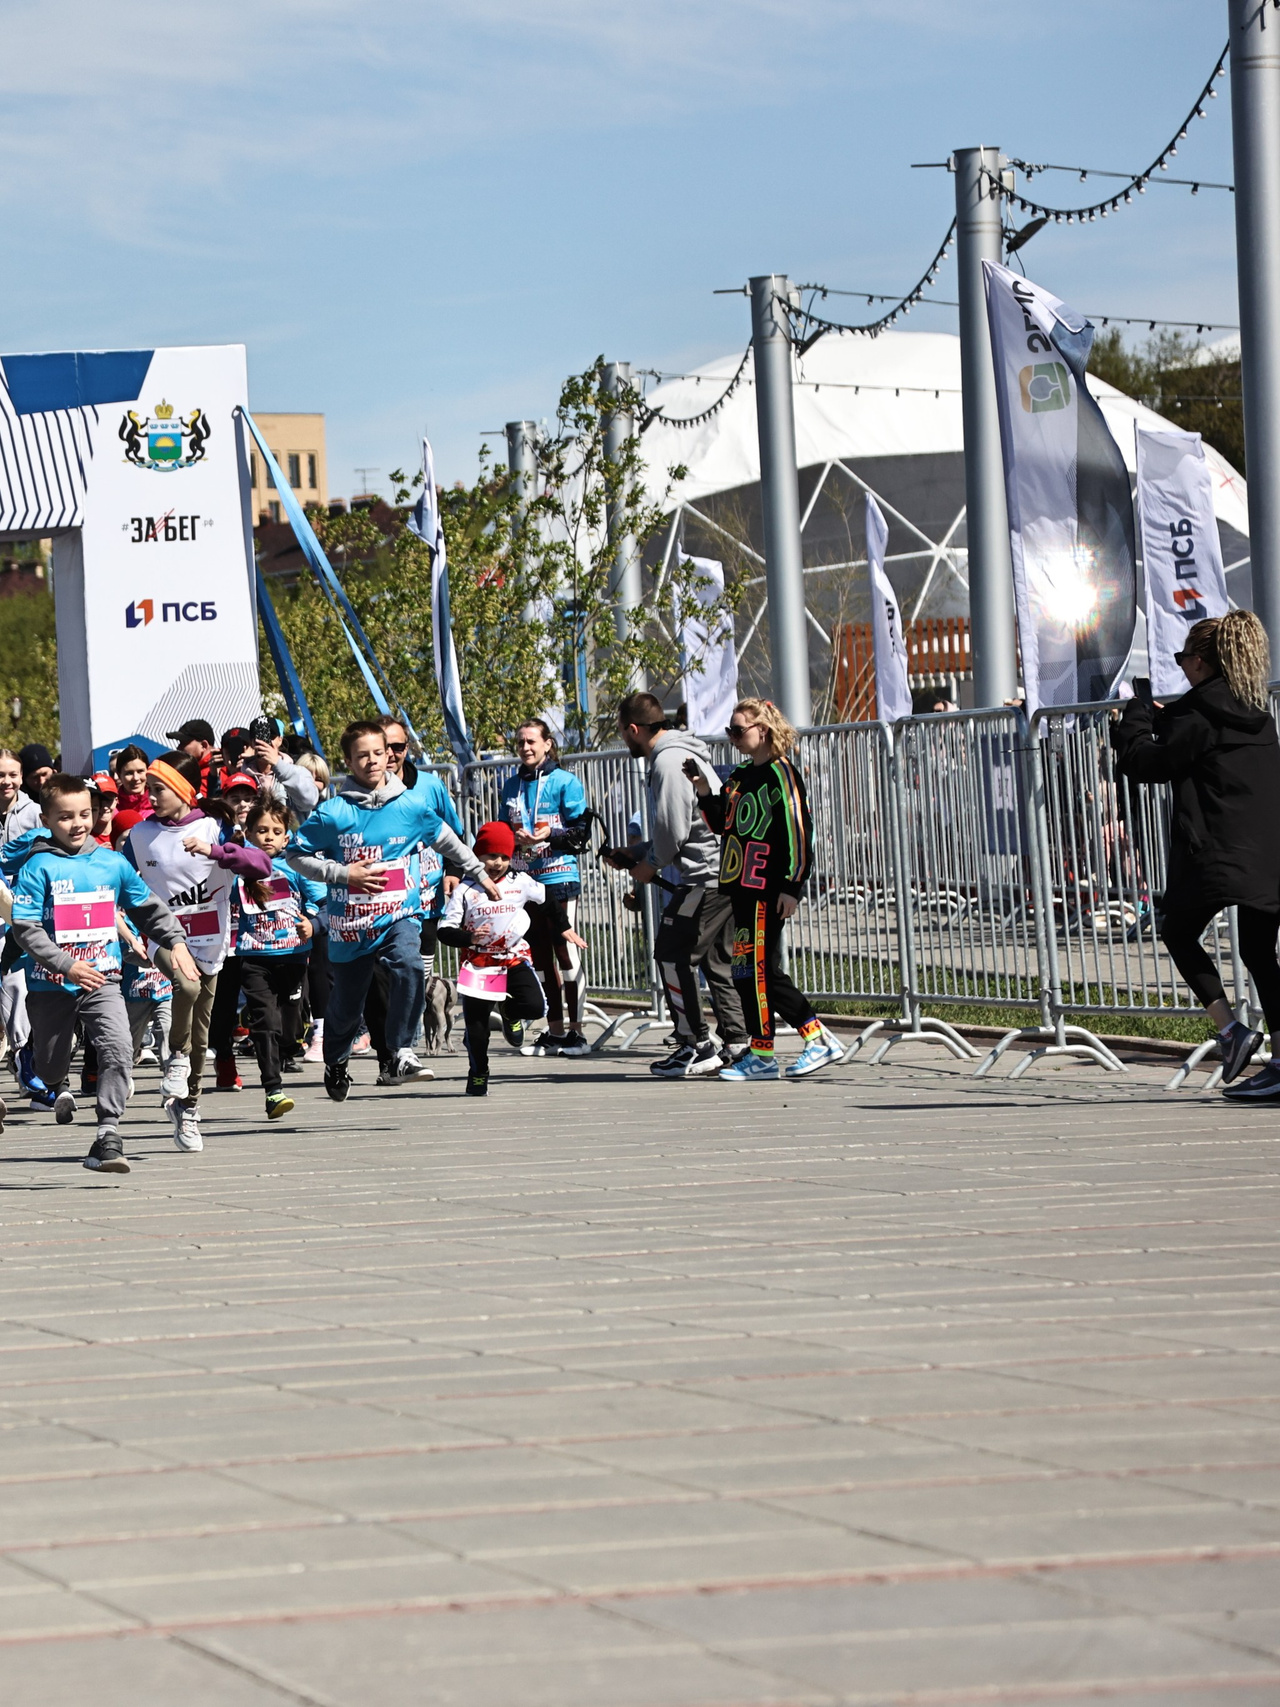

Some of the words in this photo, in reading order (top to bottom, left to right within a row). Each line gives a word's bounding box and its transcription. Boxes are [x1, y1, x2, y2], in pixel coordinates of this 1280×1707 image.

[1169, 516, 1196, 580] ПСБ
[162, 601, 218, 623] ПСБ
[338, 832, 364, 848] 2024
[51, 879, 74, 895] 2024
[476, 904, 516, 917] ТЮМЕНЬ
[83, 912, 91, 927] 1
[185, 923, 192, 935] 1
